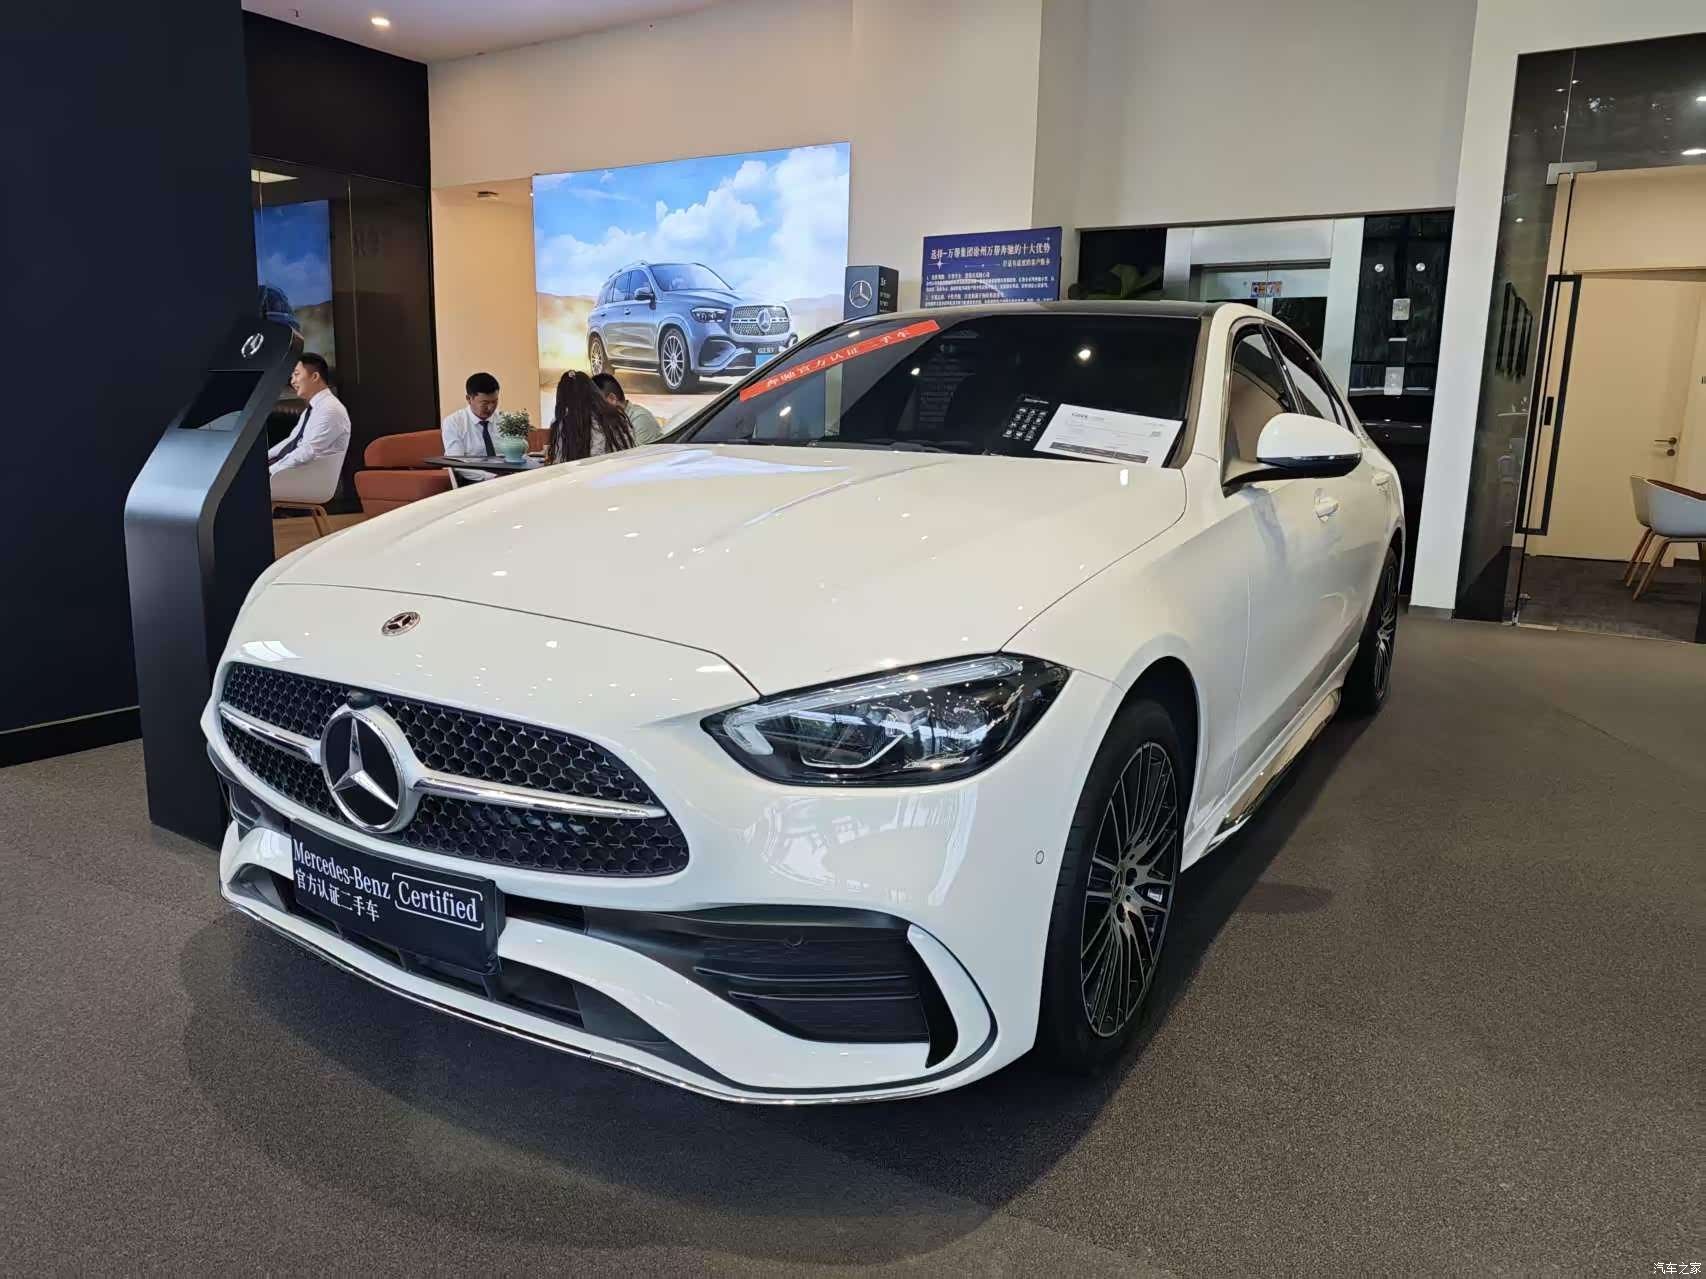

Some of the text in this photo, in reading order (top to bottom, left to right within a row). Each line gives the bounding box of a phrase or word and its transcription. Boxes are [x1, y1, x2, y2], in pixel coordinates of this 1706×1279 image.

[293, 838, 478, 923] Mercedes-Benz Certified
[295, 868, 380, 923] 官方认证二手车
